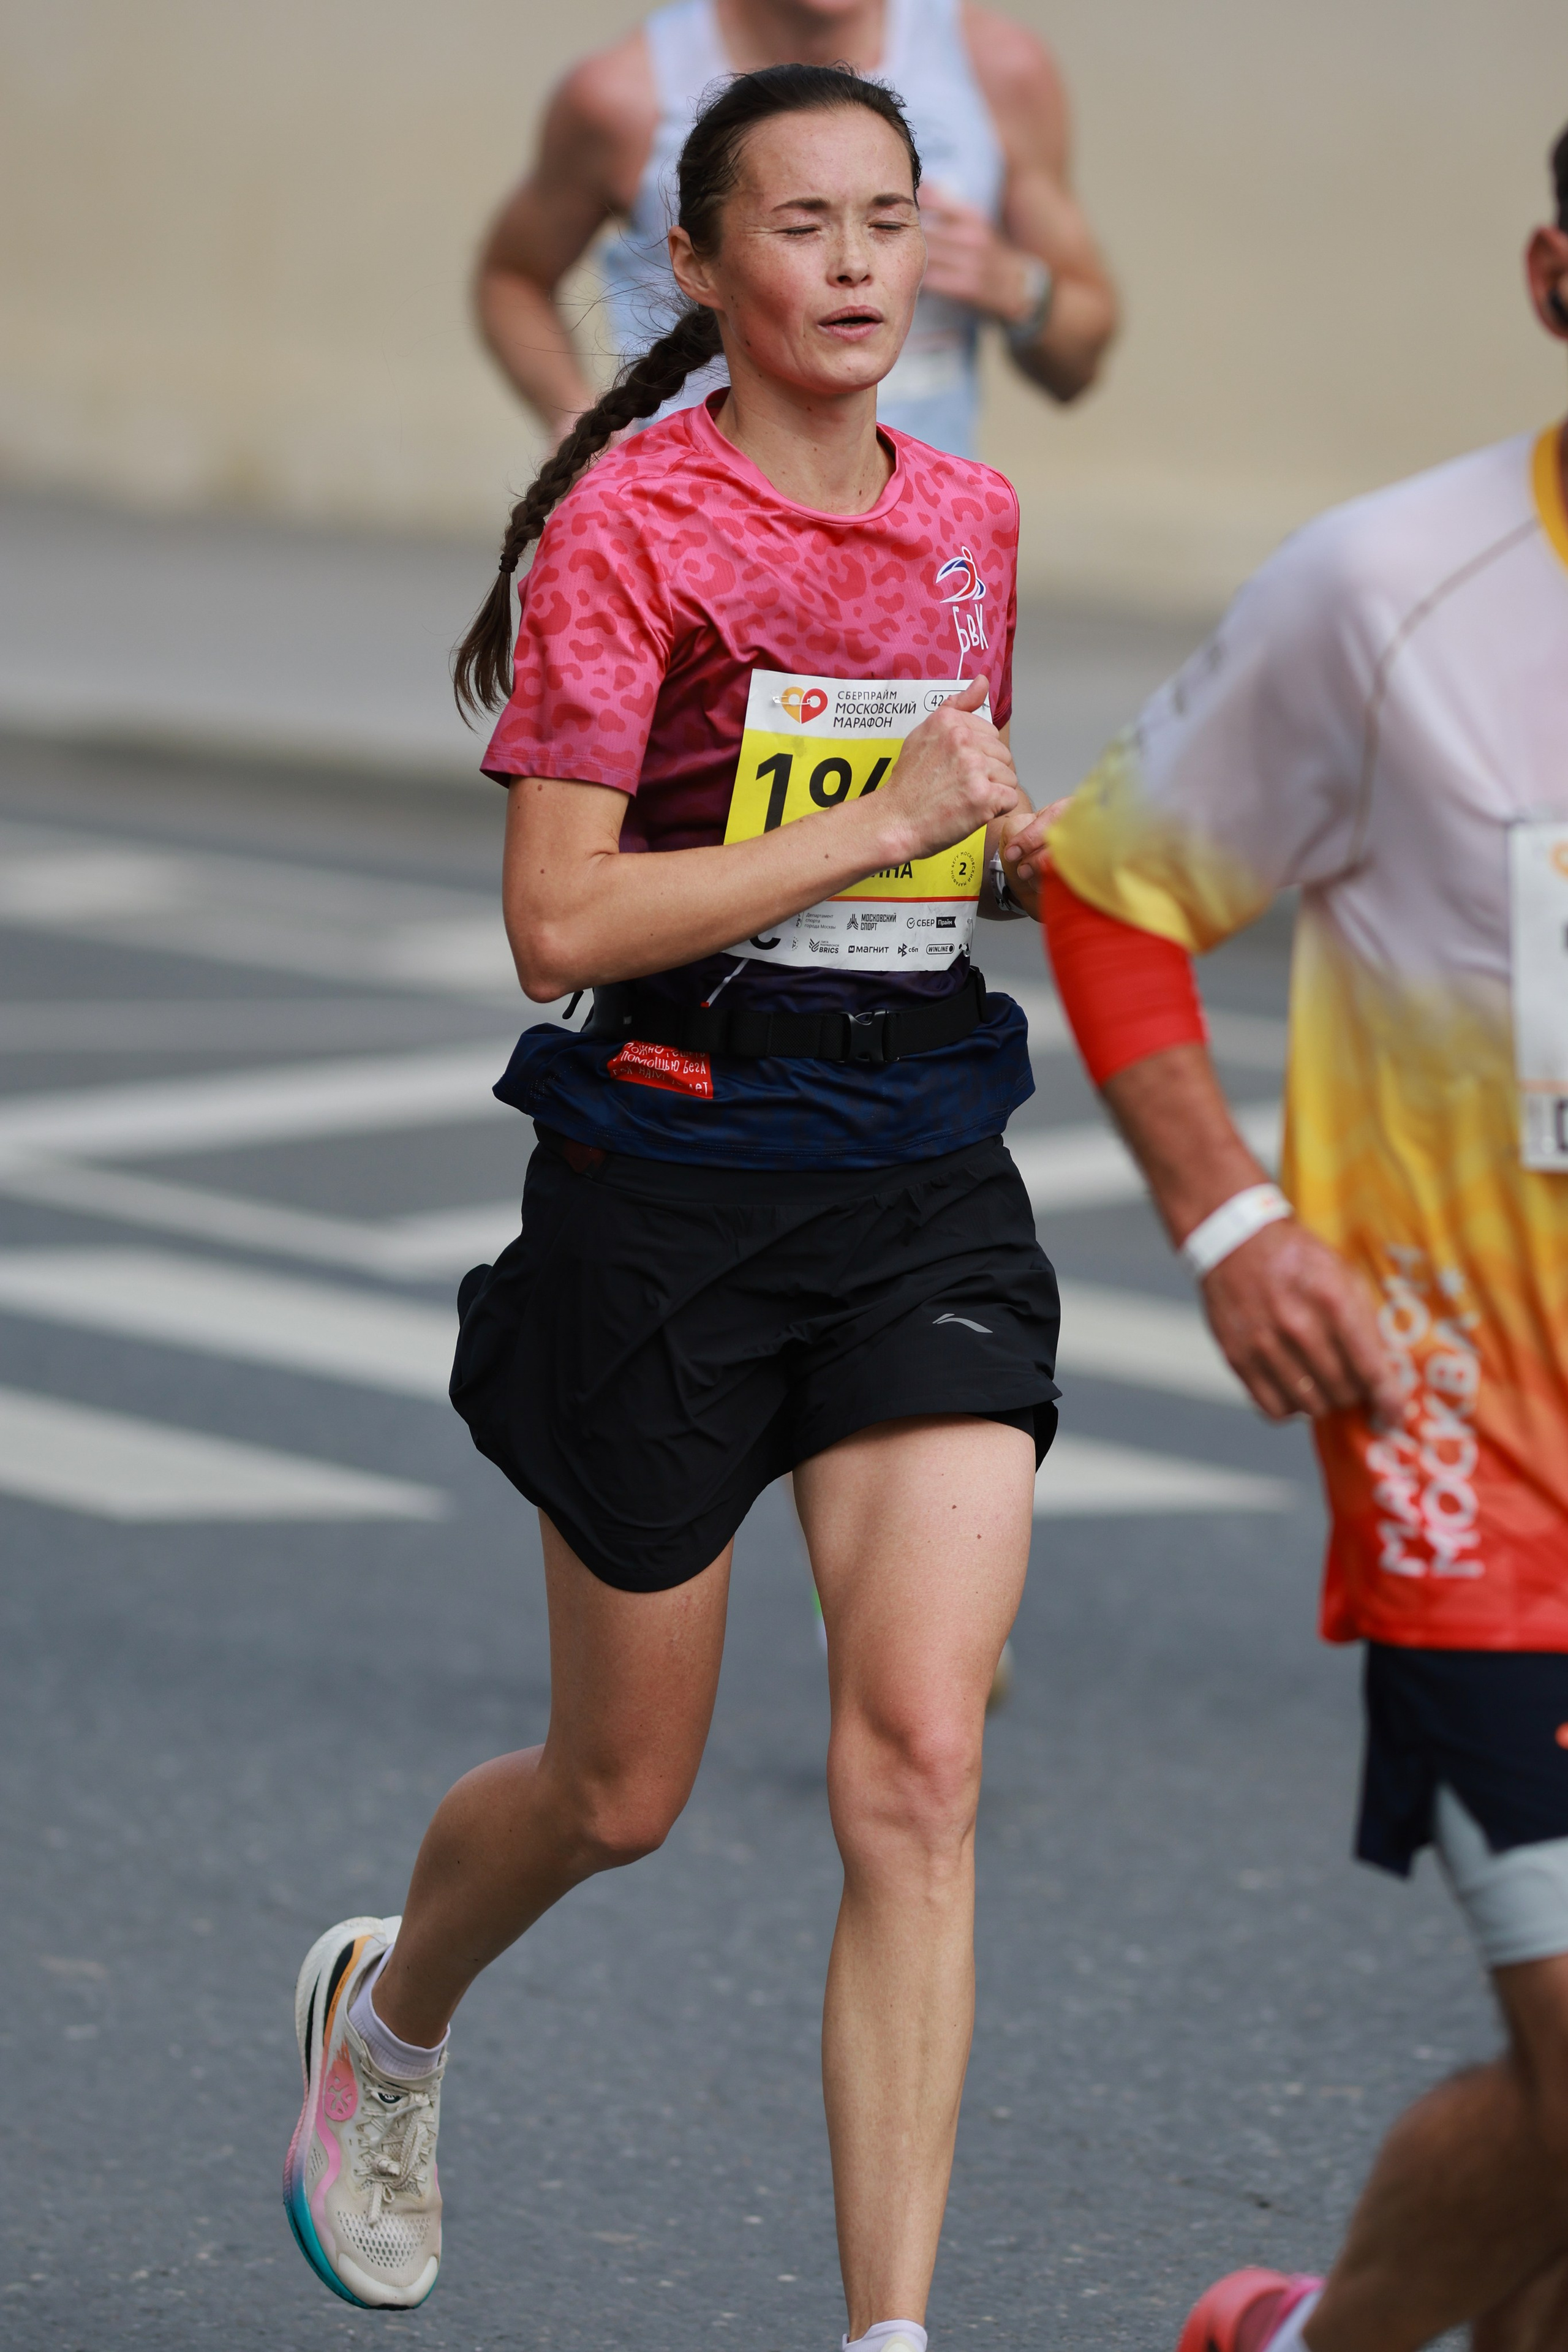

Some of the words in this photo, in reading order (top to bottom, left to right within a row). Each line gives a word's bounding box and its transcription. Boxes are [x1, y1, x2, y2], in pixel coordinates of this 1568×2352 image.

[837, 690, 897, 700] СБЕРПРАЙМ
[835, 701, 917, 715] МОСКОВСКИЙ
[833, 717, 893, 728] МАРАФОН
[959, 862, 967, 875] 2
[960, 851, 975, 882] МОСКОВСКИЙ
[951, 870, 967, 886] МАРАФОН
[861, 913, 897, 922] МОСКОВСКИЙ
